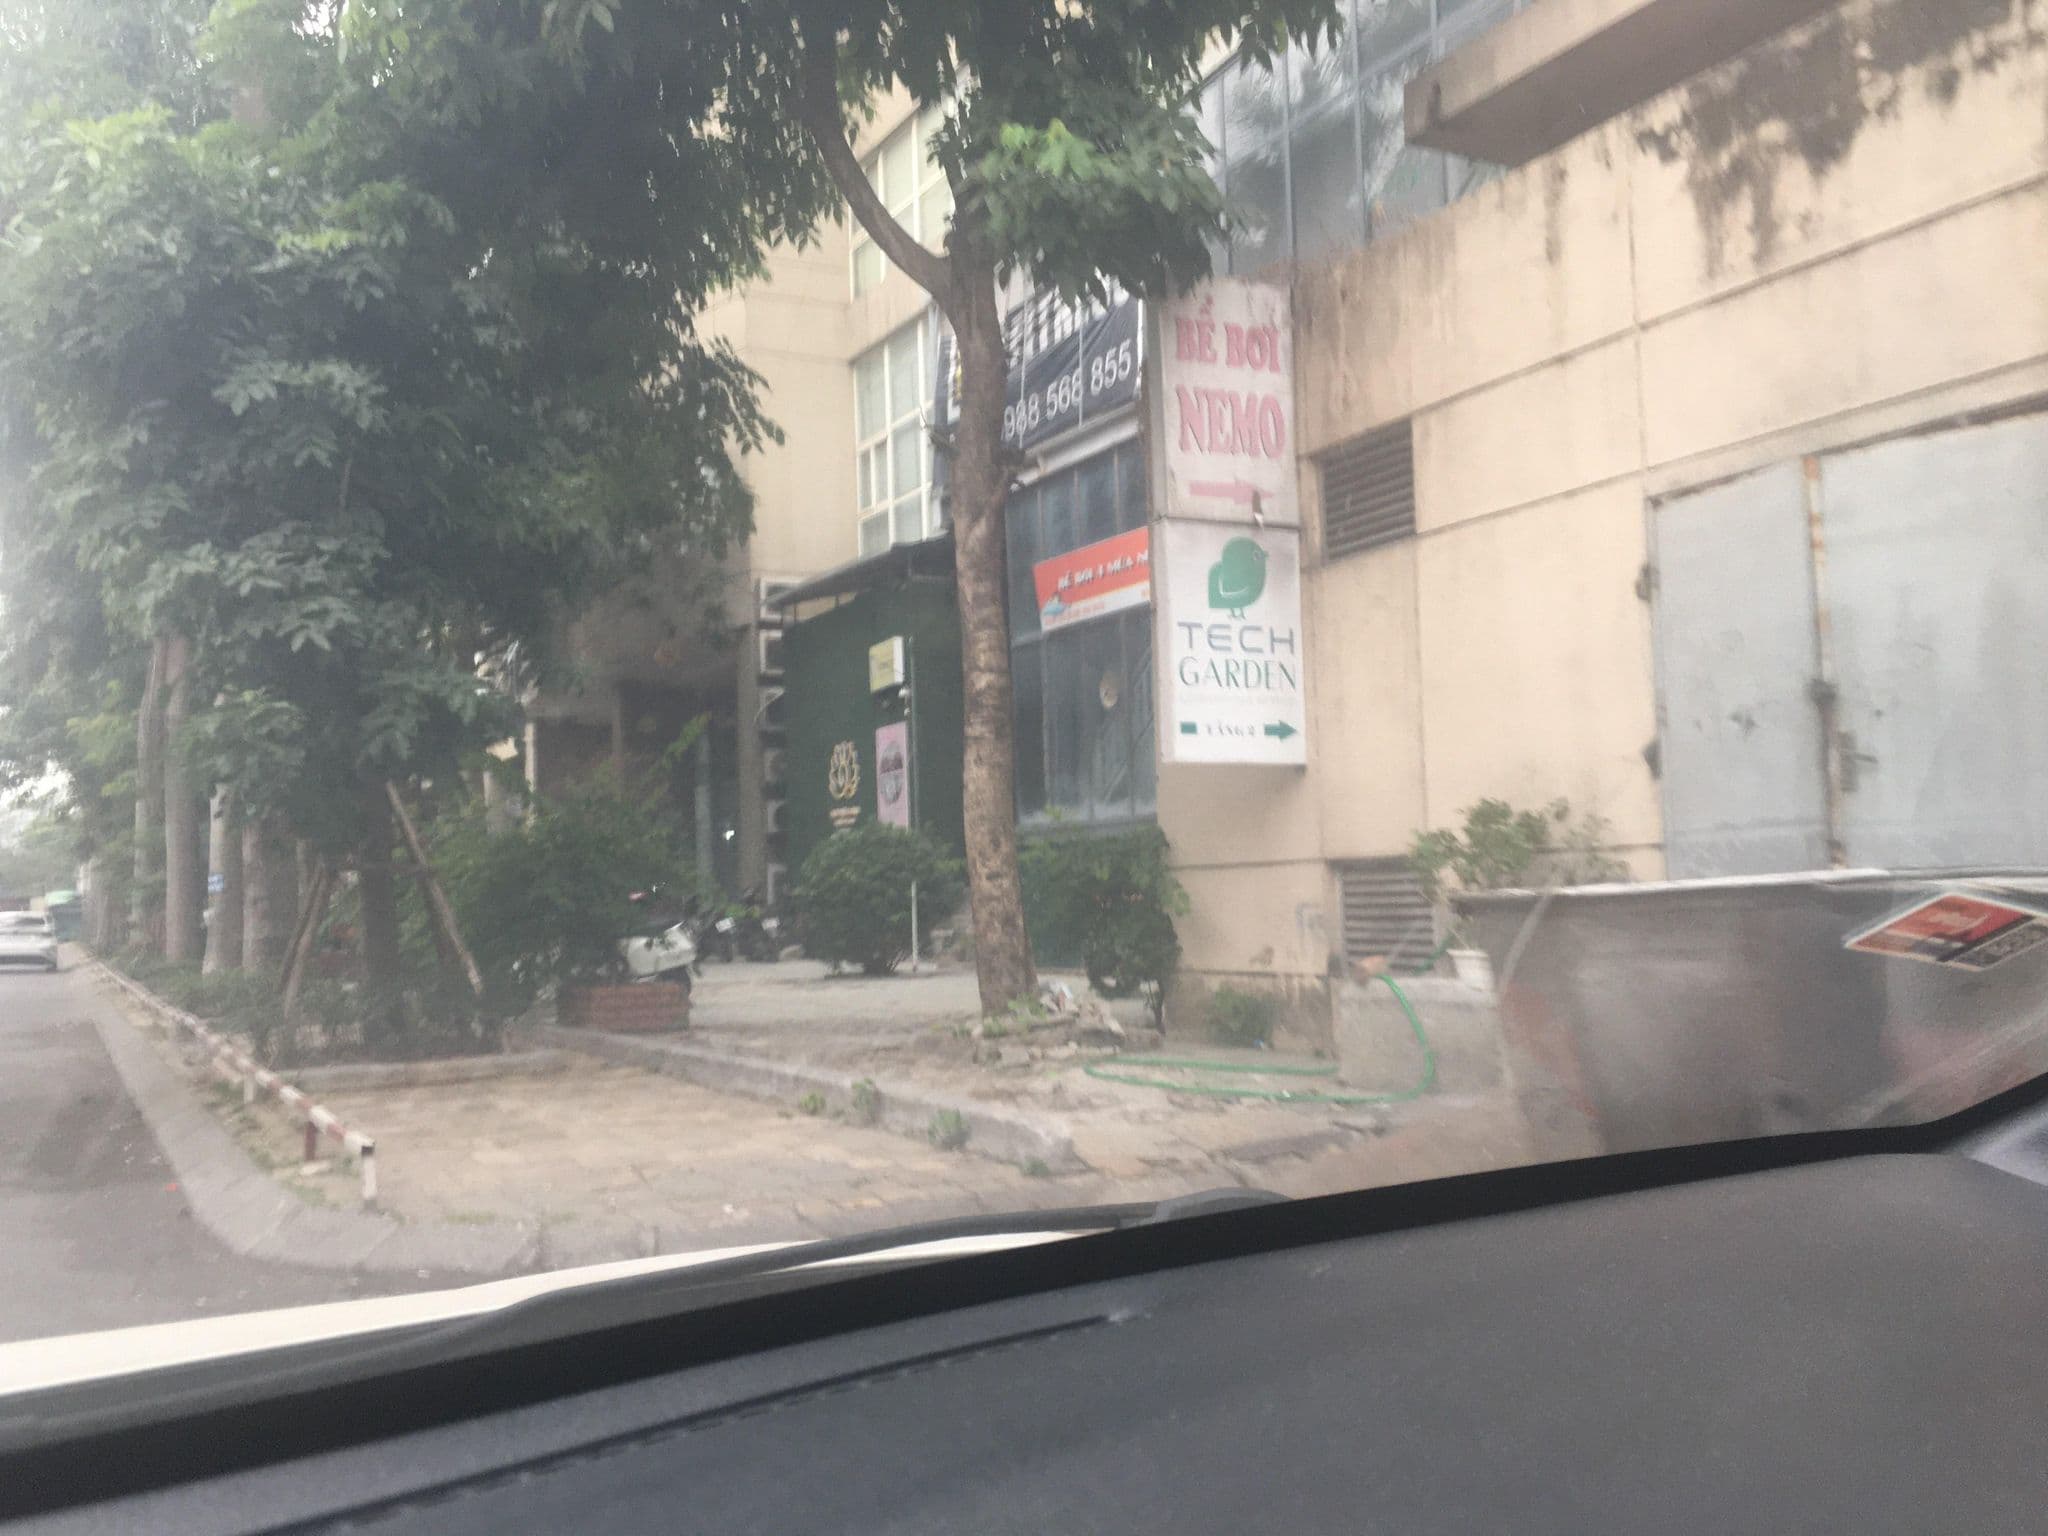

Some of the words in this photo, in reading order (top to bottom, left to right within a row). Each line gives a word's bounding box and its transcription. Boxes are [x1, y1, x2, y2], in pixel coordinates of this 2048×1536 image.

[1046, 367, 1083, 421] 568
[1091, 338, 1131, 396] 855
[1176, 384, 1286, 460] NEMO
[1178, 621, 1295, 656] TECH
[1179, 656, 1296, 691] GARDEN
